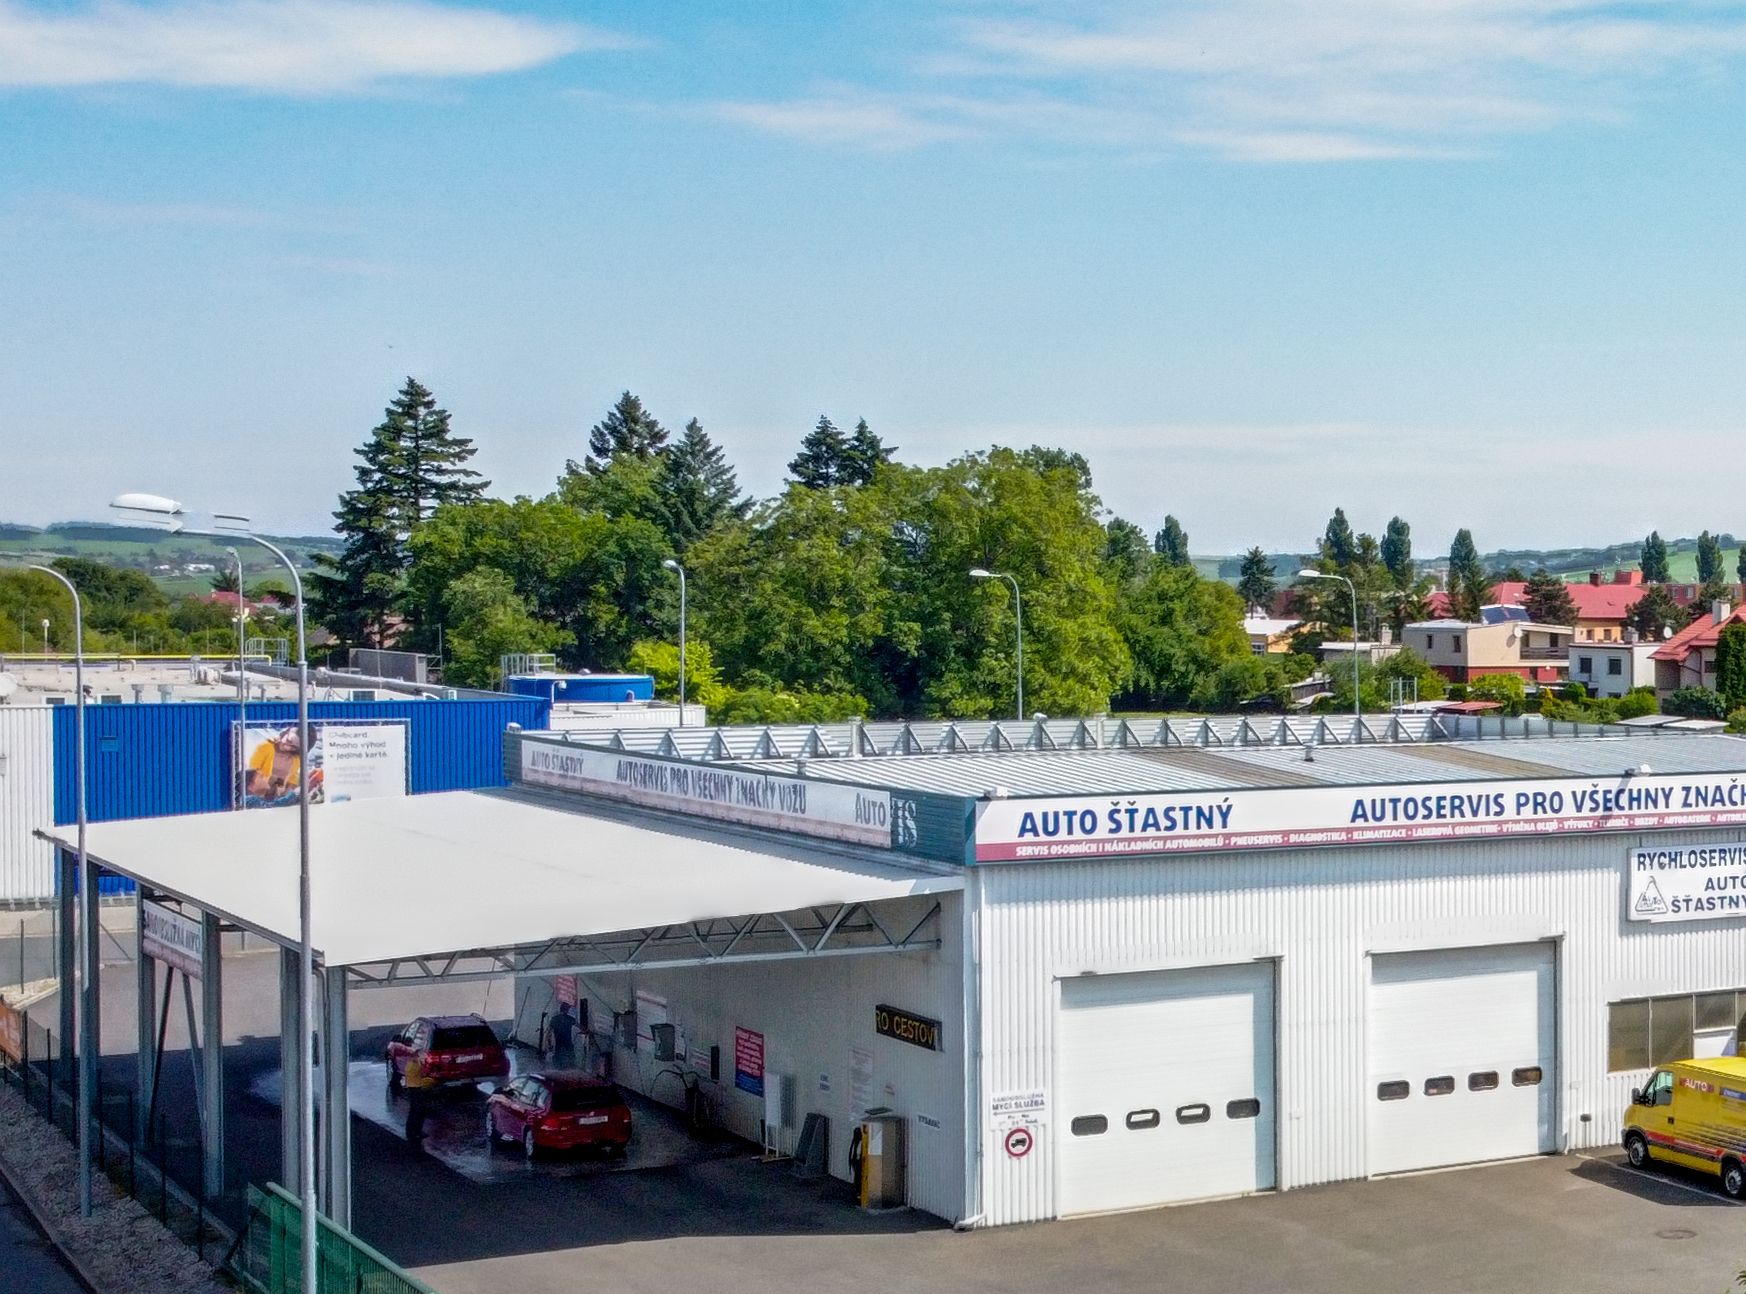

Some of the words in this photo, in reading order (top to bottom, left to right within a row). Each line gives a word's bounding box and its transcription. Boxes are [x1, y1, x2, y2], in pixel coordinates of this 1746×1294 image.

[670, 766, 689, 796] PRO
[855, 792, 887, 827] AUTO
[1017, 808, 1099, 838] AUTO
[1107, 796, 1234, 834] ŠŤASTNÝ
[1350, 792, 1506, 824] AUTOSERVIS
[1515, 790, 1565, 816] PRO
[1571, 782, 1675, 813] VŠECHNY
[1016, 845, 1049, 857] SERVIS
[1051, 841, 1097, 854] OSOBNÍCH
[1104, 838, 1164, 852] NÁKLADNÍCH
[1165, 834, 1224, 849] AUTOMOBILŮ
[1230, 833, 1283, 846] PNEUSERVIS
[1289, 831, 1347, 843] DIAGNOSTIKA
[1352, 828, 1406, 840] KLIMATIZACE
